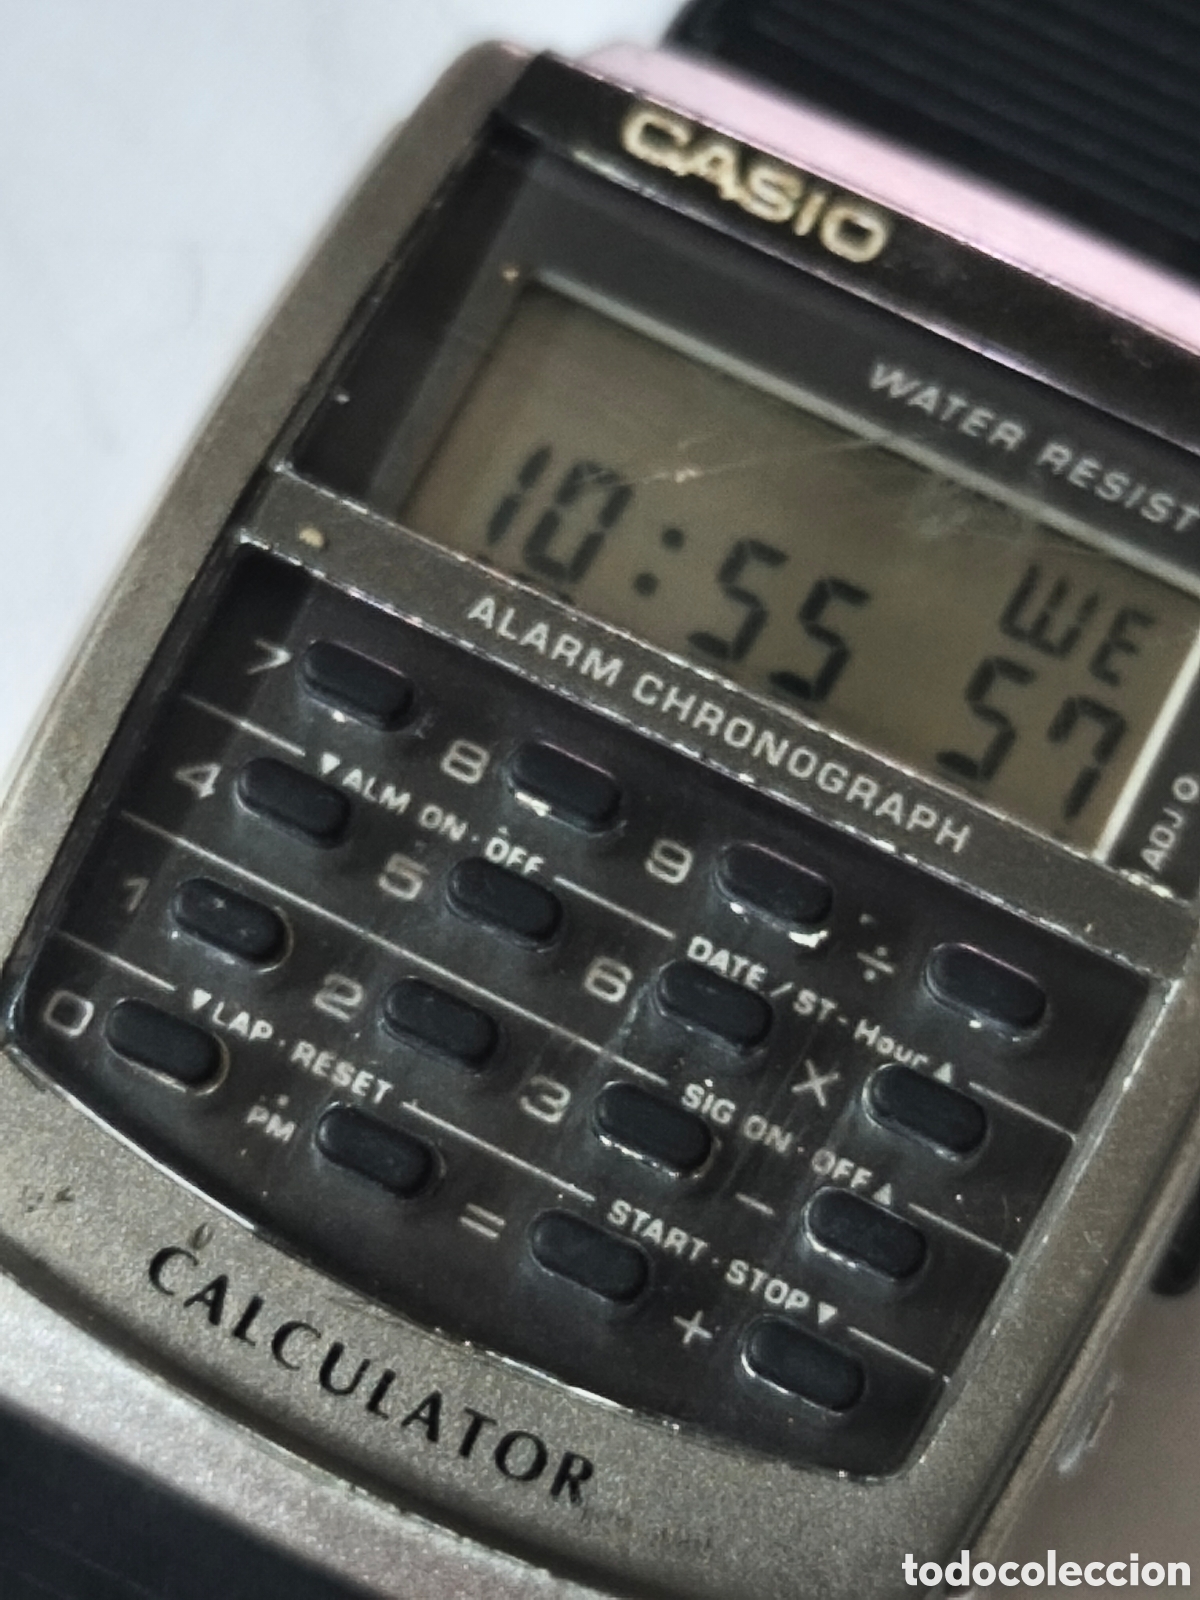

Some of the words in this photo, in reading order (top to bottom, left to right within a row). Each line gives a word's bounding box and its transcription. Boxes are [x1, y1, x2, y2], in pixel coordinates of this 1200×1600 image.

[620, 110, 889, 262] CASIO
[869, 362, 1027, 451] WATER
[1036, 441, 1200, 532] RESIST
[483, 443, 870, 702] 10:55
[1000, 563, 1156, 686] WE
[468, 597, 621, 689] ALARM
[631, 672, 972, 855] CHRONOGRAPH
[936, 655, 1129, 820] 57
[173, 761, 222, 799] 4
[440, 739, 491, 785] 8
[342, 768, 411, 815] ALM
[644, 838, 693, 885] 9
[1140, 806, 1185, 874] ADJ
[122, 874, 151, 913] 1
[377, 852, 430, 901] 5
[583, 955, 635, 1003] 6
[686, 935, 768, 991] DATE
[313, 971, 365, 1022] 2
[211, 1001, 274, 1041] LAP
[290, 1040, 394, 1105] RESET
[246, 1104, 297, 1143] PM
[520, 1075, 572, 1126] 3
[681, 1083, 736, 1125] SIG
[607, 1199, 709, 1264] START
[725, 1262, 811, 1313] STOP
[146, 1244, 596, 1505] CALCULATOR
